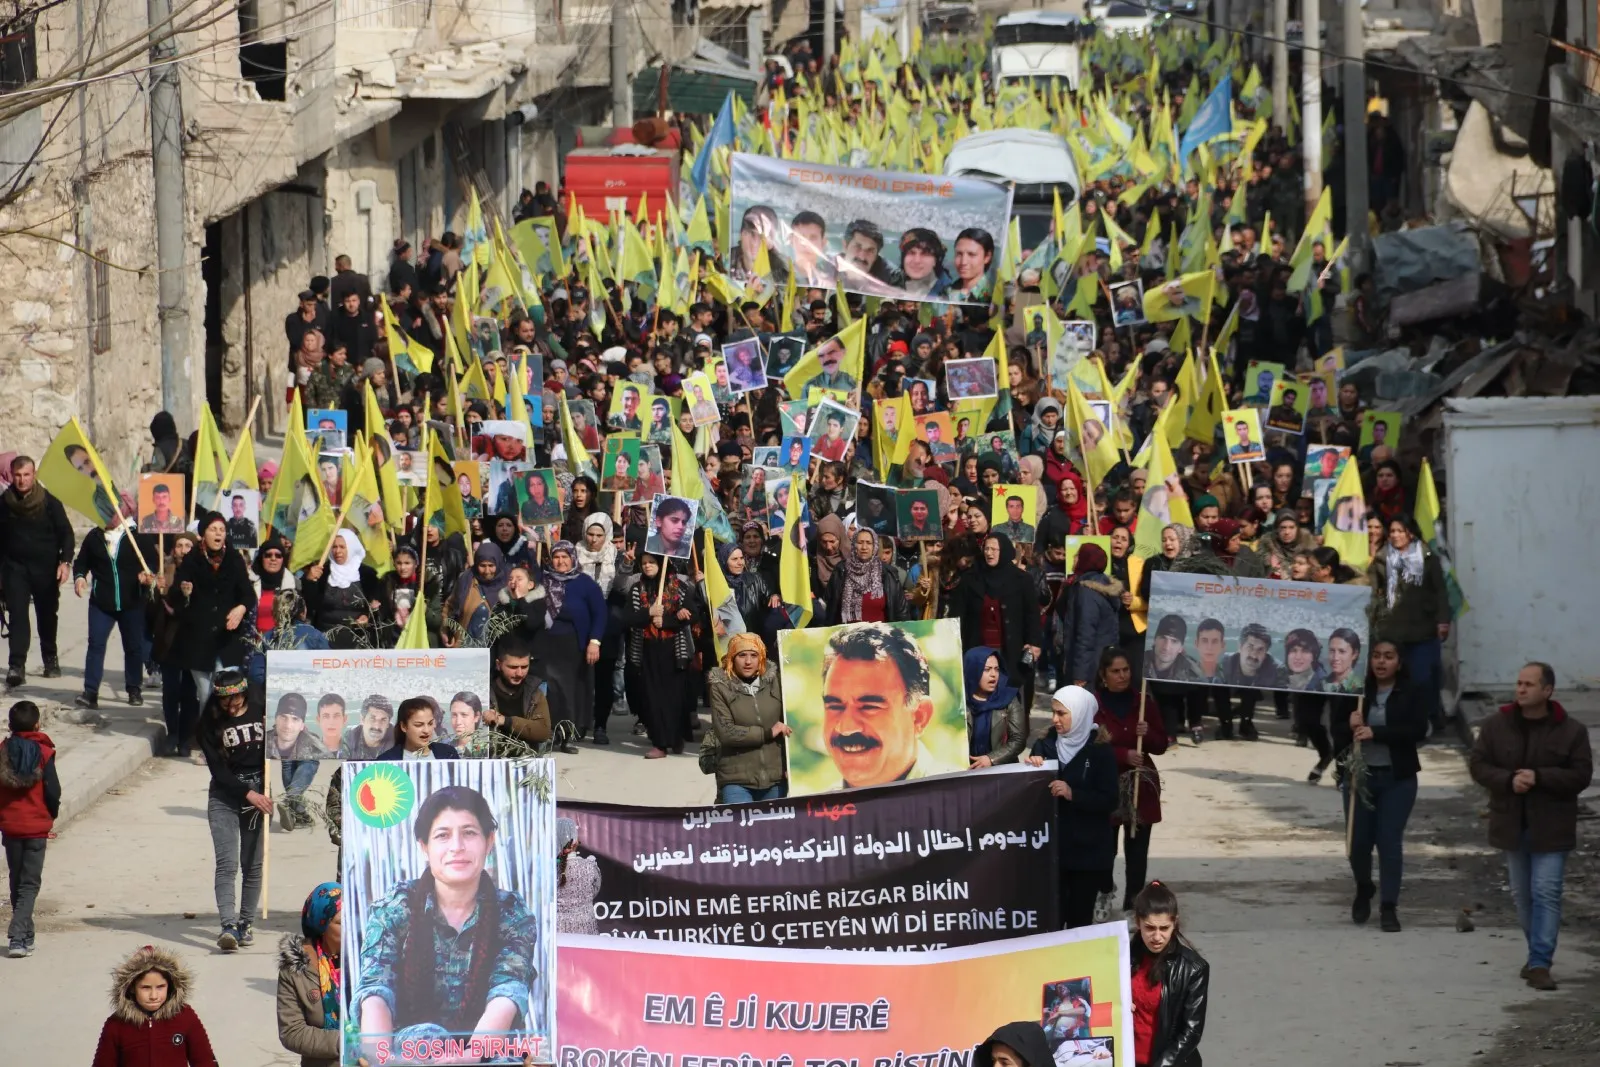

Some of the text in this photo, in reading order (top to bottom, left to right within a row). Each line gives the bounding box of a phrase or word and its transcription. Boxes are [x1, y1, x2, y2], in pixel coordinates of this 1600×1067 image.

[312, 654, 447, 669] FEDAYIYÊN EFRÎNÊ
[222, 722, 264, 748] BTS
[853, 831, 911, 860] الدولة
[979, 830, 1027, 850] يدوم
[1031, 821, 1050, 850] لن
[633, 843, 694, 873] لعفرين
[697, 893, 742, 916] EMÊ
[747, 889, 822, 914] EFRÎNÊ
[827, 886, 907, 909] RİZGAR
[751, 921, 766, 942] Û
[771, 914, 867, 945] ÇETEYÊN
[871, 912, 899, 935] WÎ
[933, 907, 1007, 932] EFRÎNÊ
[1012, 910, 1038, 929] DE
[643, 993, 696, 1025] EM
[703, 992, 725, 1027] Ê
[765, 997, 890, 1031] KUJERÊ
[376, 1040, 395, 1064] Ş.
[401, 1038, 465, 1060] SOSIN
